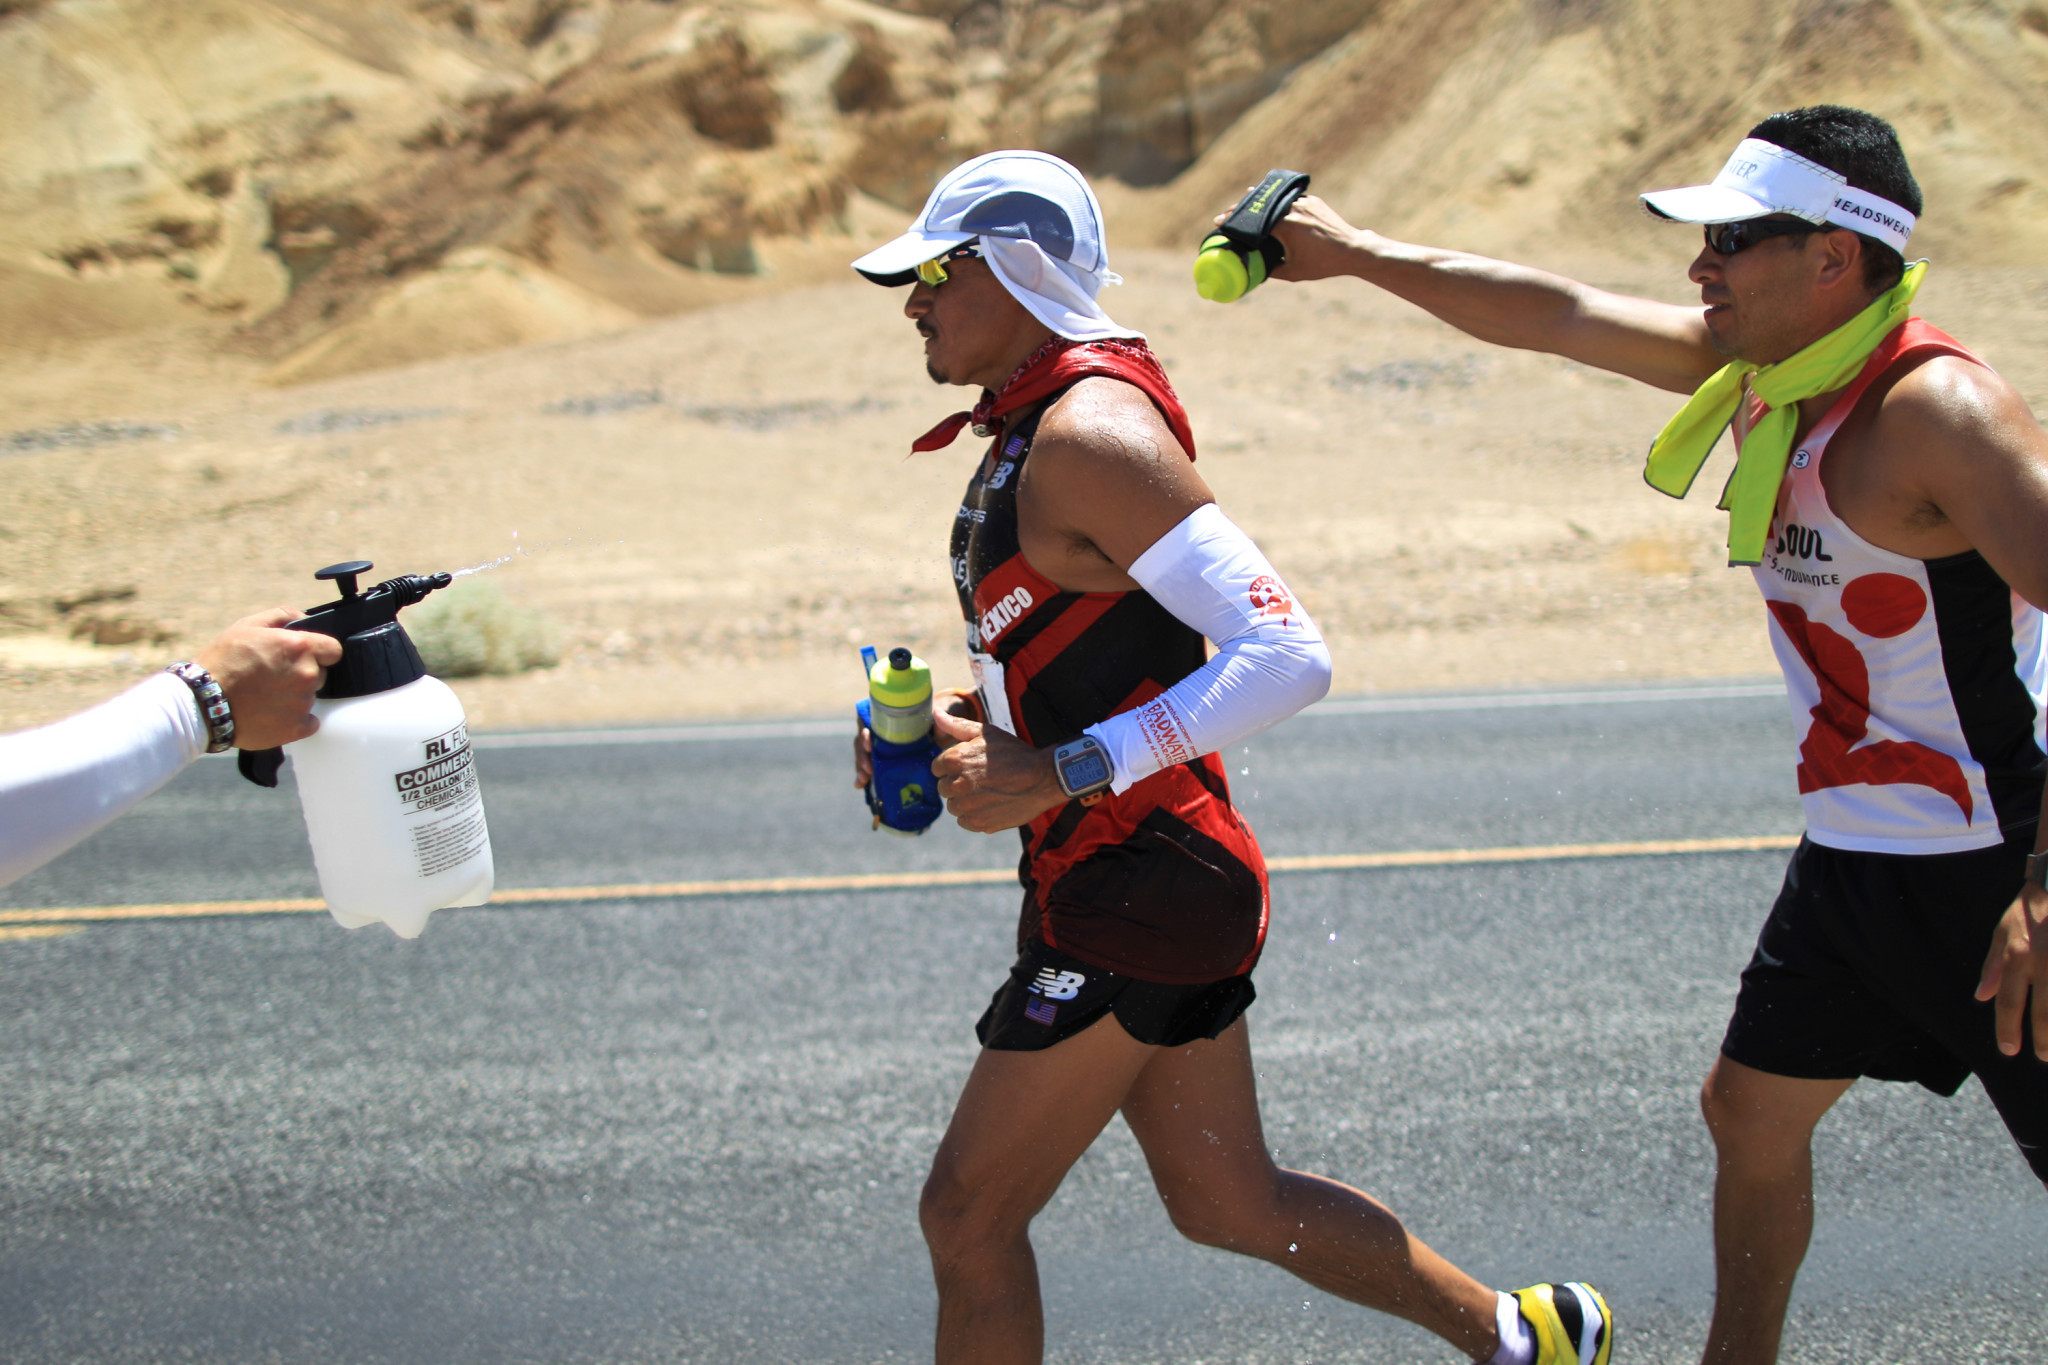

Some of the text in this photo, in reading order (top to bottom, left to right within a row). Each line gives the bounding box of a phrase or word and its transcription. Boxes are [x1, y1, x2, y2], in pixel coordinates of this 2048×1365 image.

[426, 738, 451, 761] RL
[401, 790, 421, 802] 1/2
[416, 783, 464, 810] CHEMICAL
